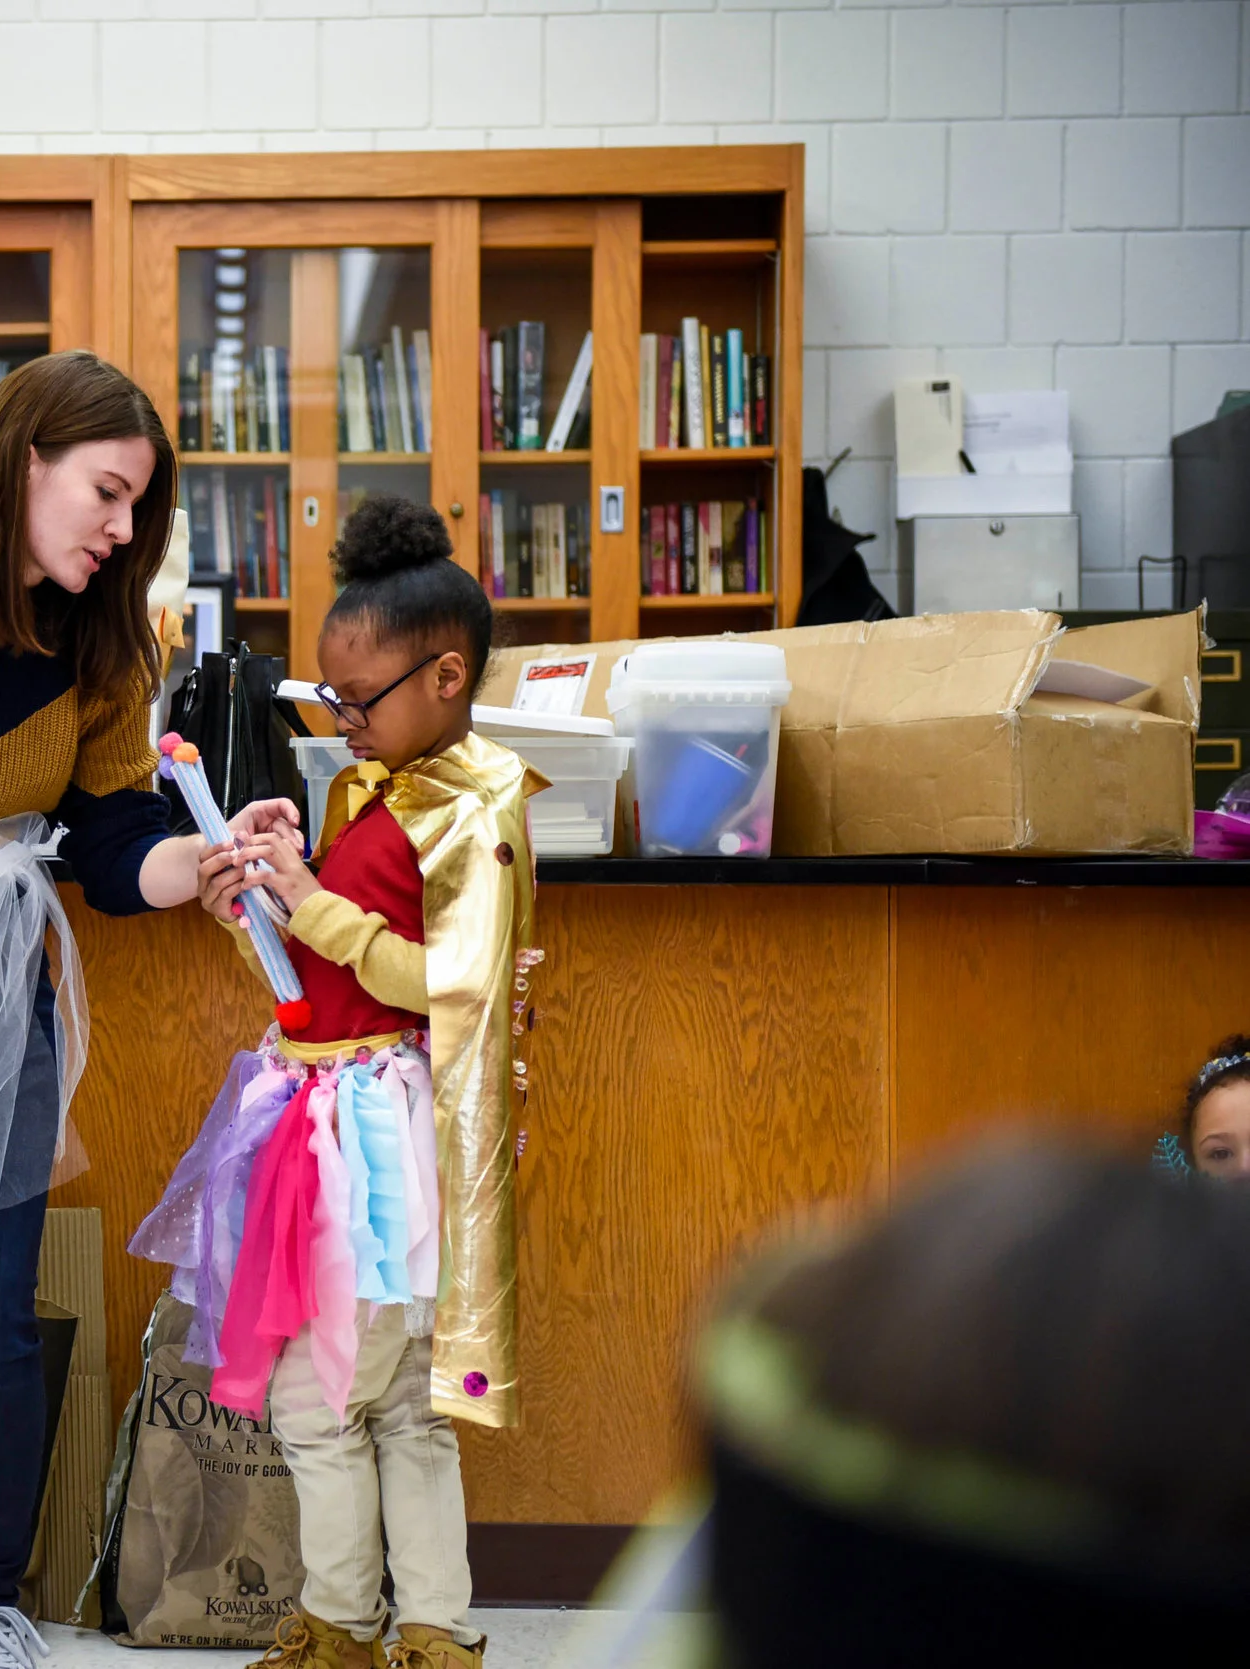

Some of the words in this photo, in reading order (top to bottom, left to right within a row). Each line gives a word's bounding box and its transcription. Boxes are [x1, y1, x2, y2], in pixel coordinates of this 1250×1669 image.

[198, 1459, 217, 1473] THE
[221, 1462, 241, 1475] JOY
[244, 1464, 259, 1477] OF
[262, 1465, 291, 1477] GOOD
[160, 1633, 193, 1645] WE'RE
[196, 1635, 211, 1646] ON
[213, 1637, 231, 1646] THE
[235, 1638, 254, 1647] GO!
